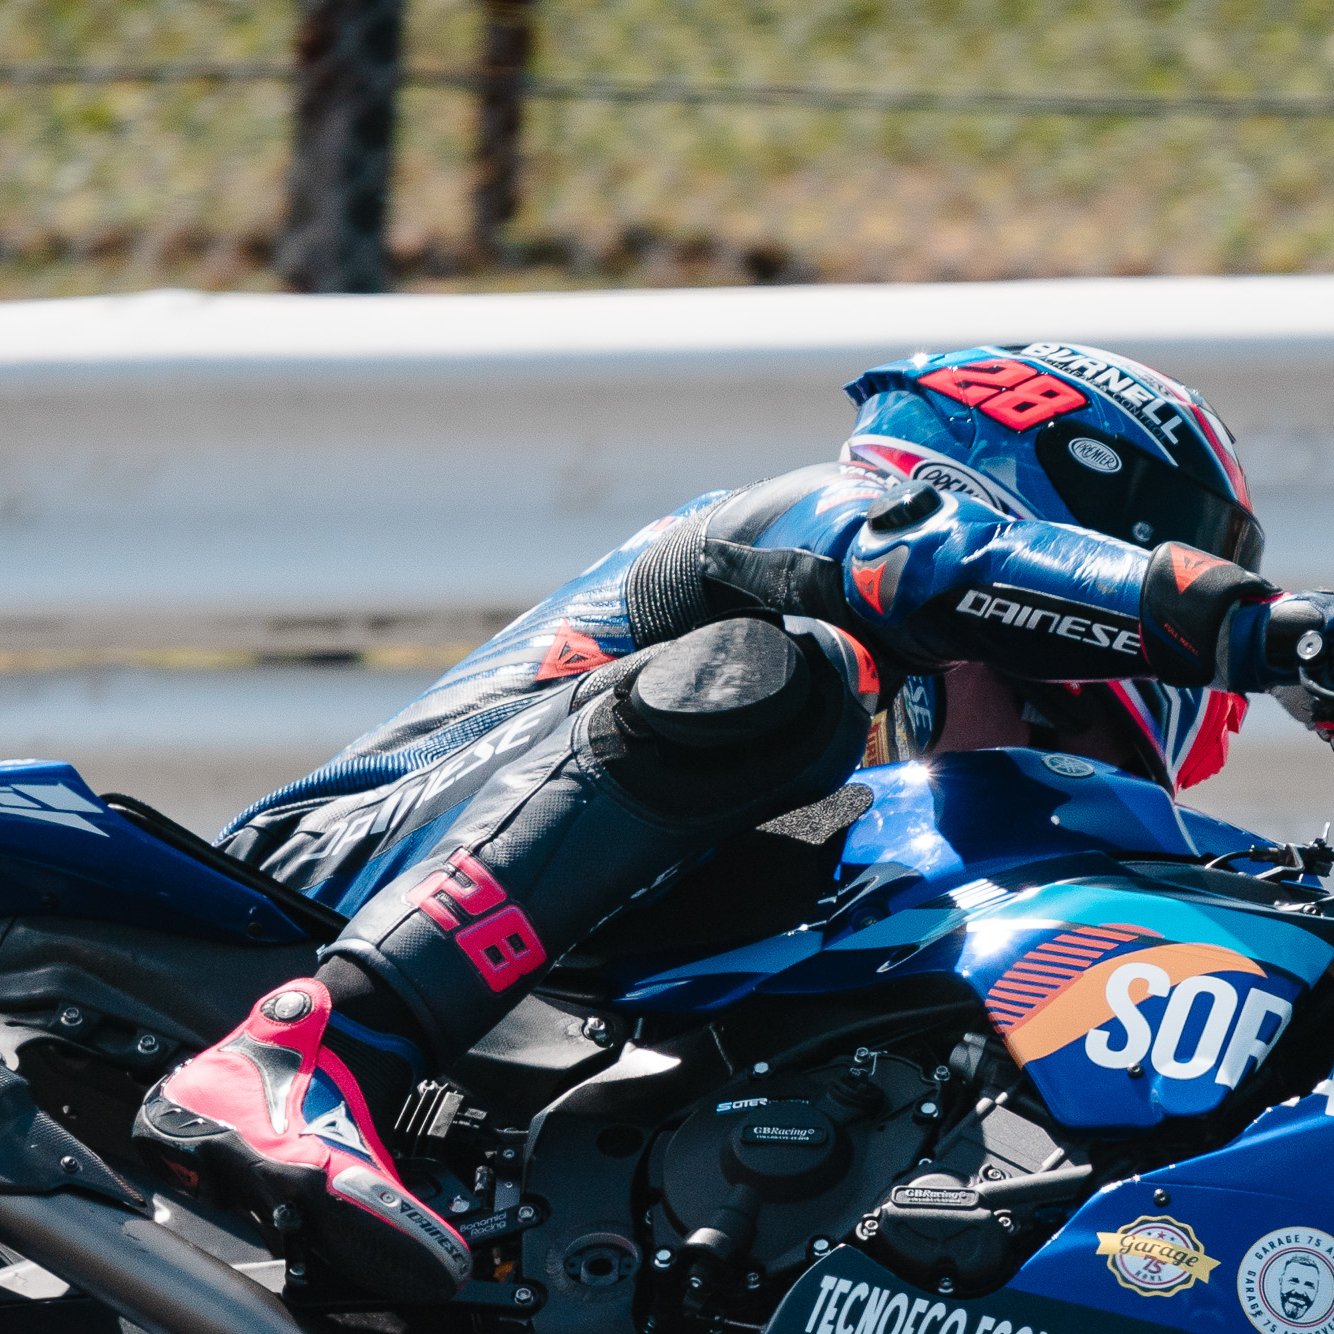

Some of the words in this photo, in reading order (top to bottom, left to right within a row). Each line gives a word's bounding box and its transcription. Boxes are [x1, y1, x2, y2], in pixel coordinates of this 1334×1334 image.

[916, 358, 1088, 433] 28
[1021, 342, 1183, 445] BURNELL
[1075, 441, 1117, 468] PREMIER
[955, 589, 1141, 655] DAINESE
[400, 847, 548, 993] 28
[407, 1207, 465, 1263] DAINESE
[460, 1212, 507, 1232] Bonamici
[470, 1220, 507, 1236] Racing
[1119, 1235, 1199, 1267] Garage
[1142, 1254, 1167, 1274] 75
[1255, 1234, 1300, 1260] GARAGE
[1308, 1235, 1322, 1248] 75
[1245, 1270, 1264, 1319] GARAGE
[1262, 1319, 1278, 1333] 75
